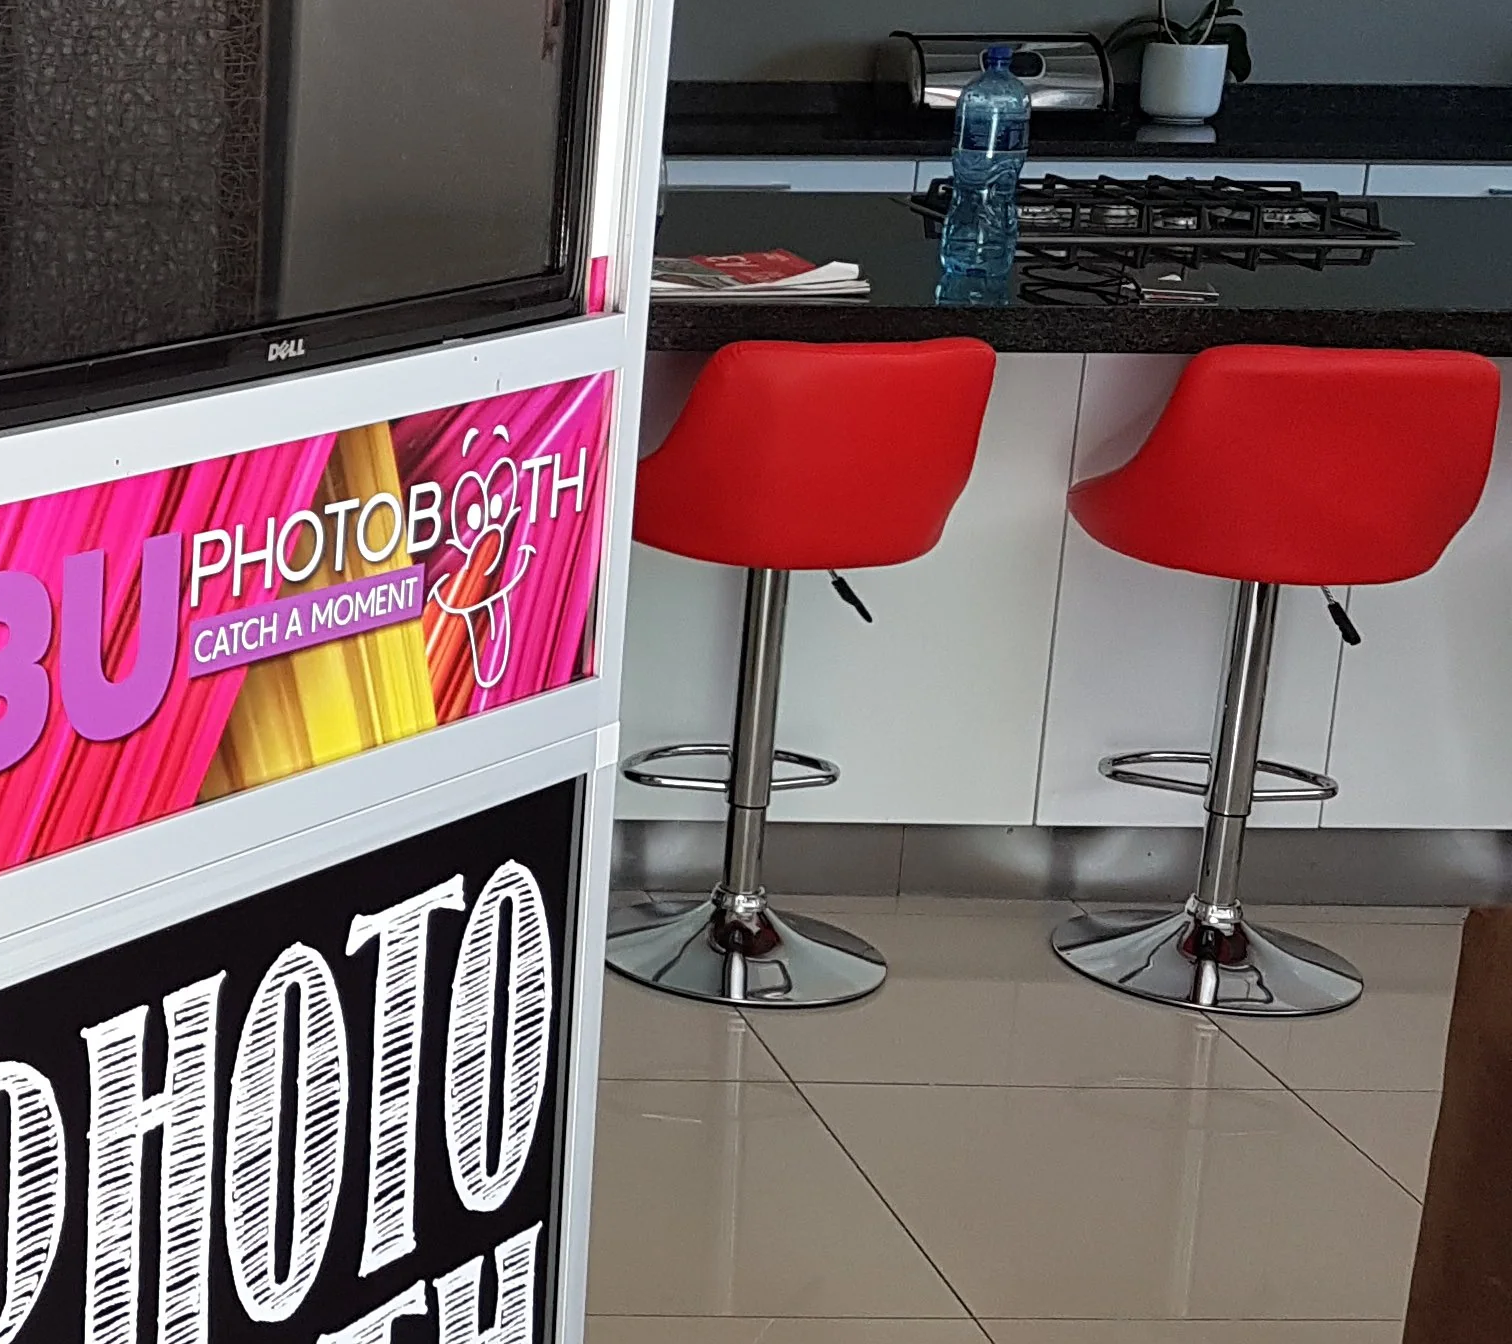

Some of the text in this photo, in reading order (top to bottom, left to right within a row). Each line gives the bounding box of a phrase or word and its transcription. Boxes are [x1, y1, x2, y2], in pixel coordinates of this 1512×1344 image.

[268, 338, 305, 361] DELL
[194, 577, 419, 663] CATCH A MOMENT
